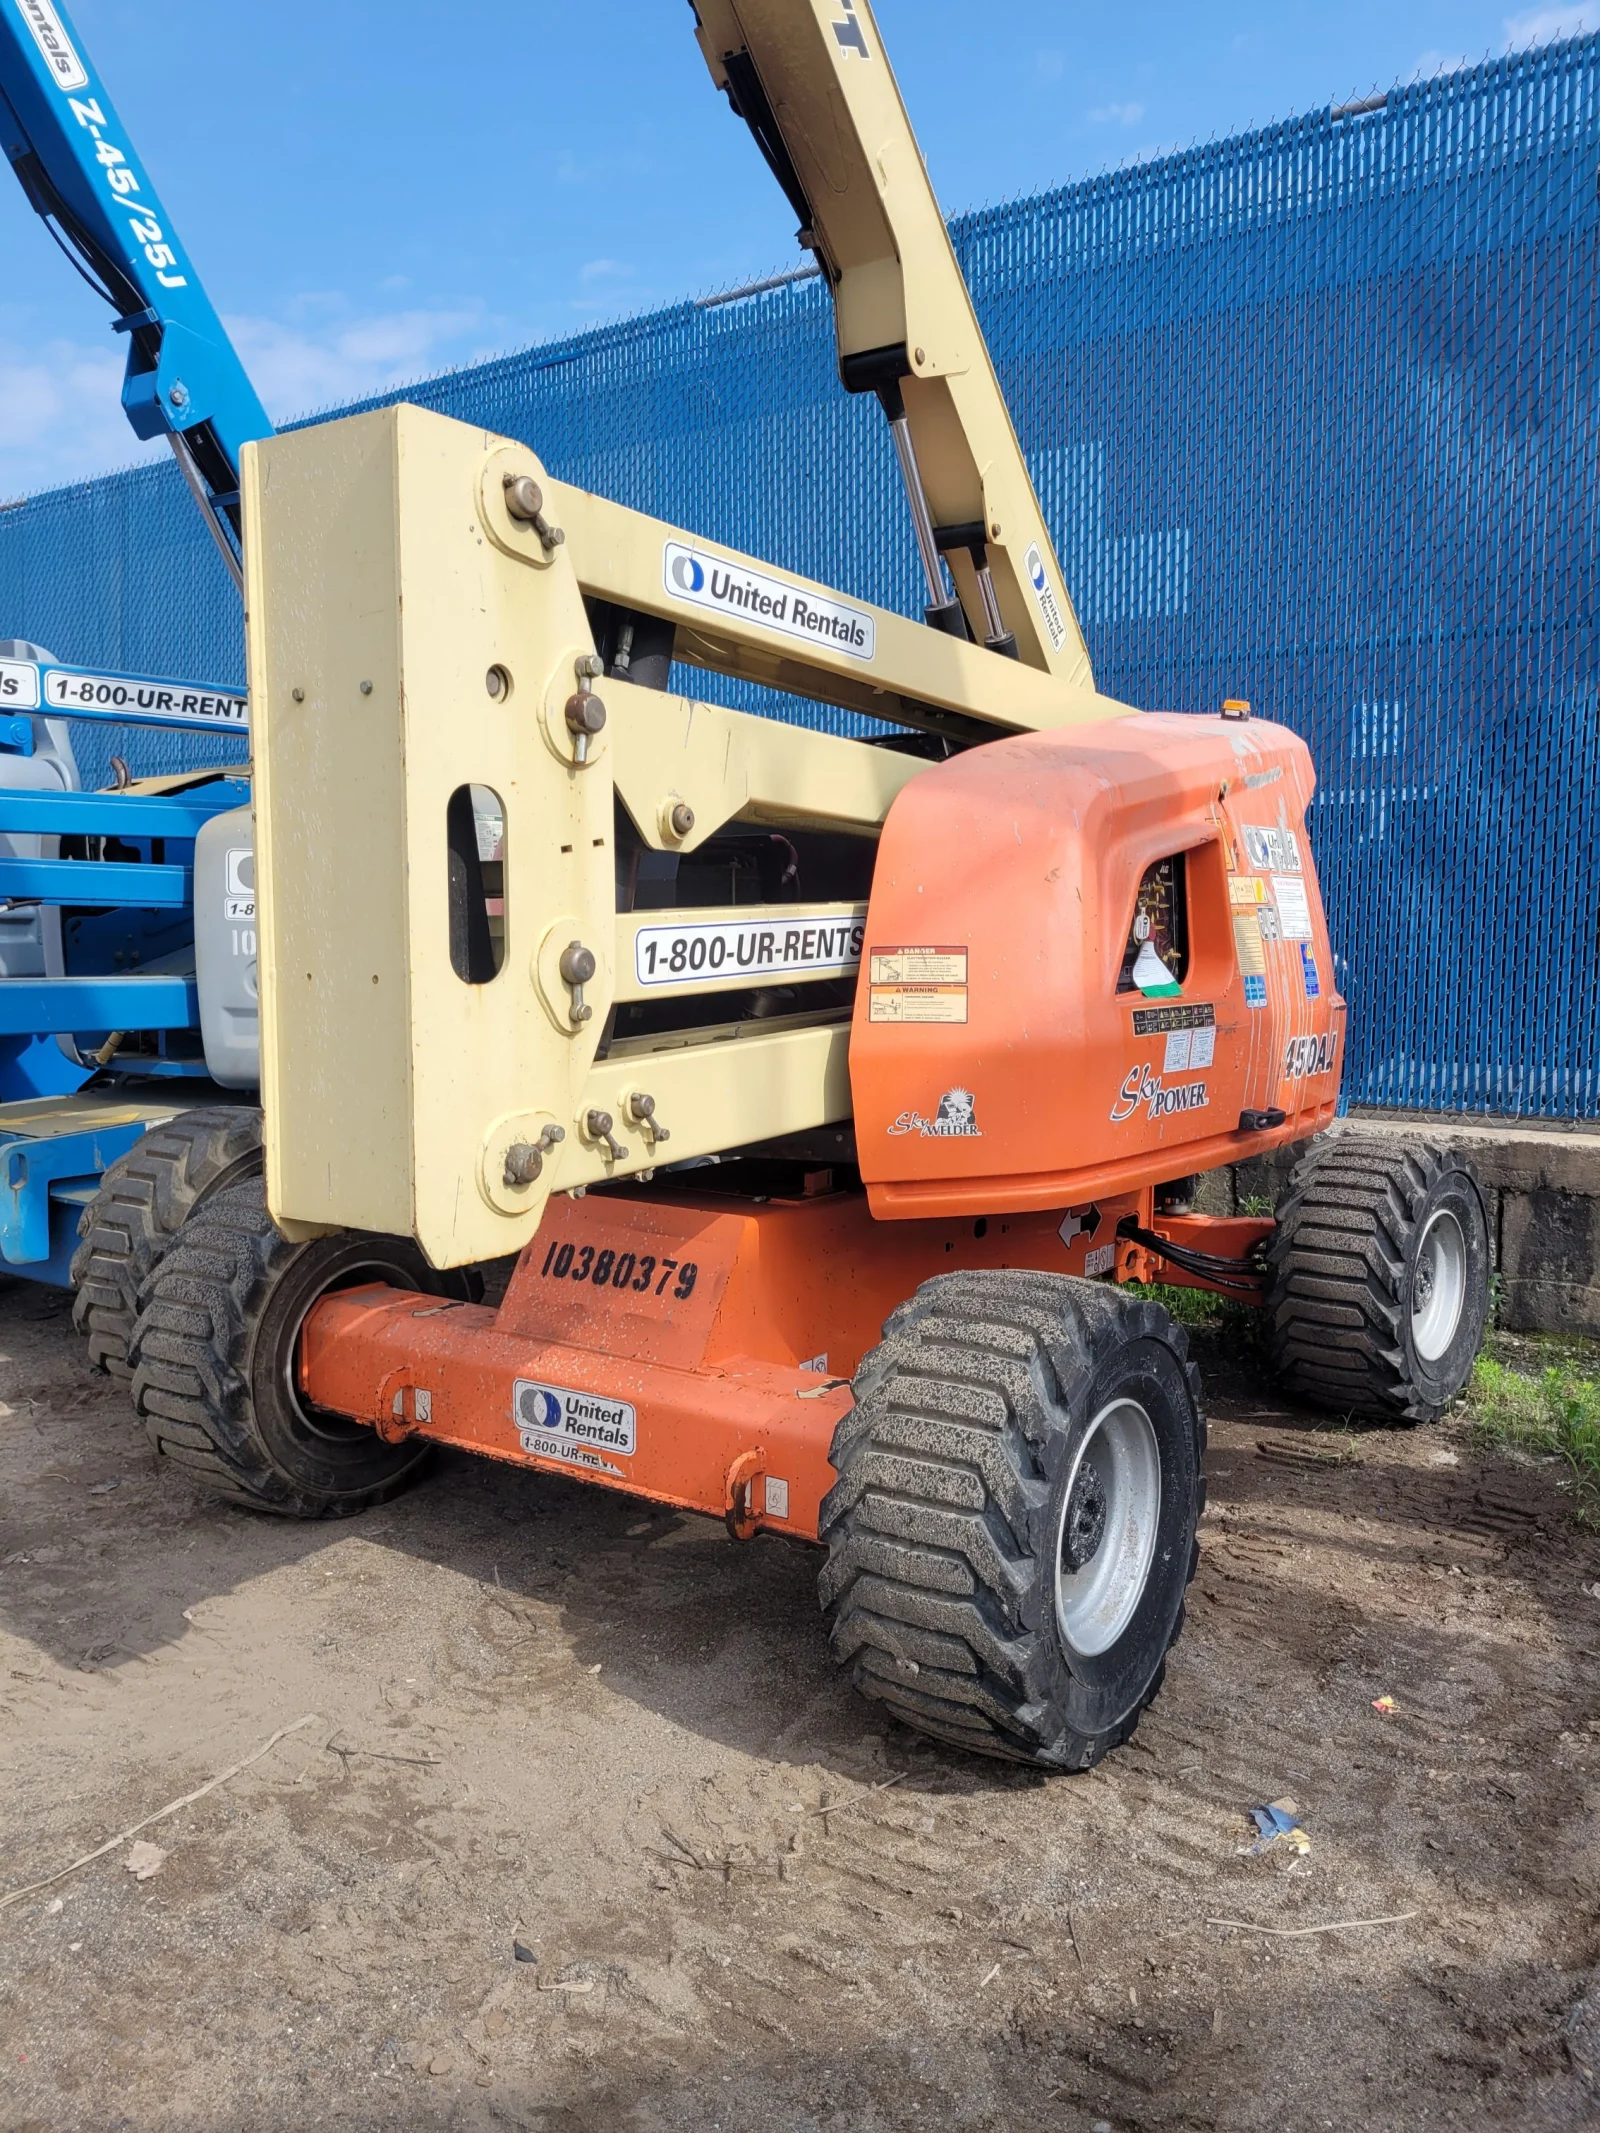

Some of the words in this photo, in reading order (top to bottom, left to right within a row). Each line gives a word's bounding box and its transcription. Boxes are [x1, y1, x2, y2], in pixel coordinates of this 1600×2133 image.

[24, 0, 71, 73] ntals
[68, 98, 187, 288] Z-45/25J
[710, 568, 788, 620] United
[792, 598, 865, 647] Rentals
[1039, 594, 1060, 648] Rentals
[1044, 586, 1064, 635] United
[644, 925, 864, 975] 1-800-UR-RENTS
[1110, 1063, 1161, 1119] Sky
[1154, 1083, 1205, 1115] POWER
[888, 1112, 930, 1136] Sky
[926, 1125, 978, 1136] WELDER
[541, 1240, 699, 1300] 10380379
[564, 1416, 629, 1447] Rentals
[565, 1397, 624, 1426] United
